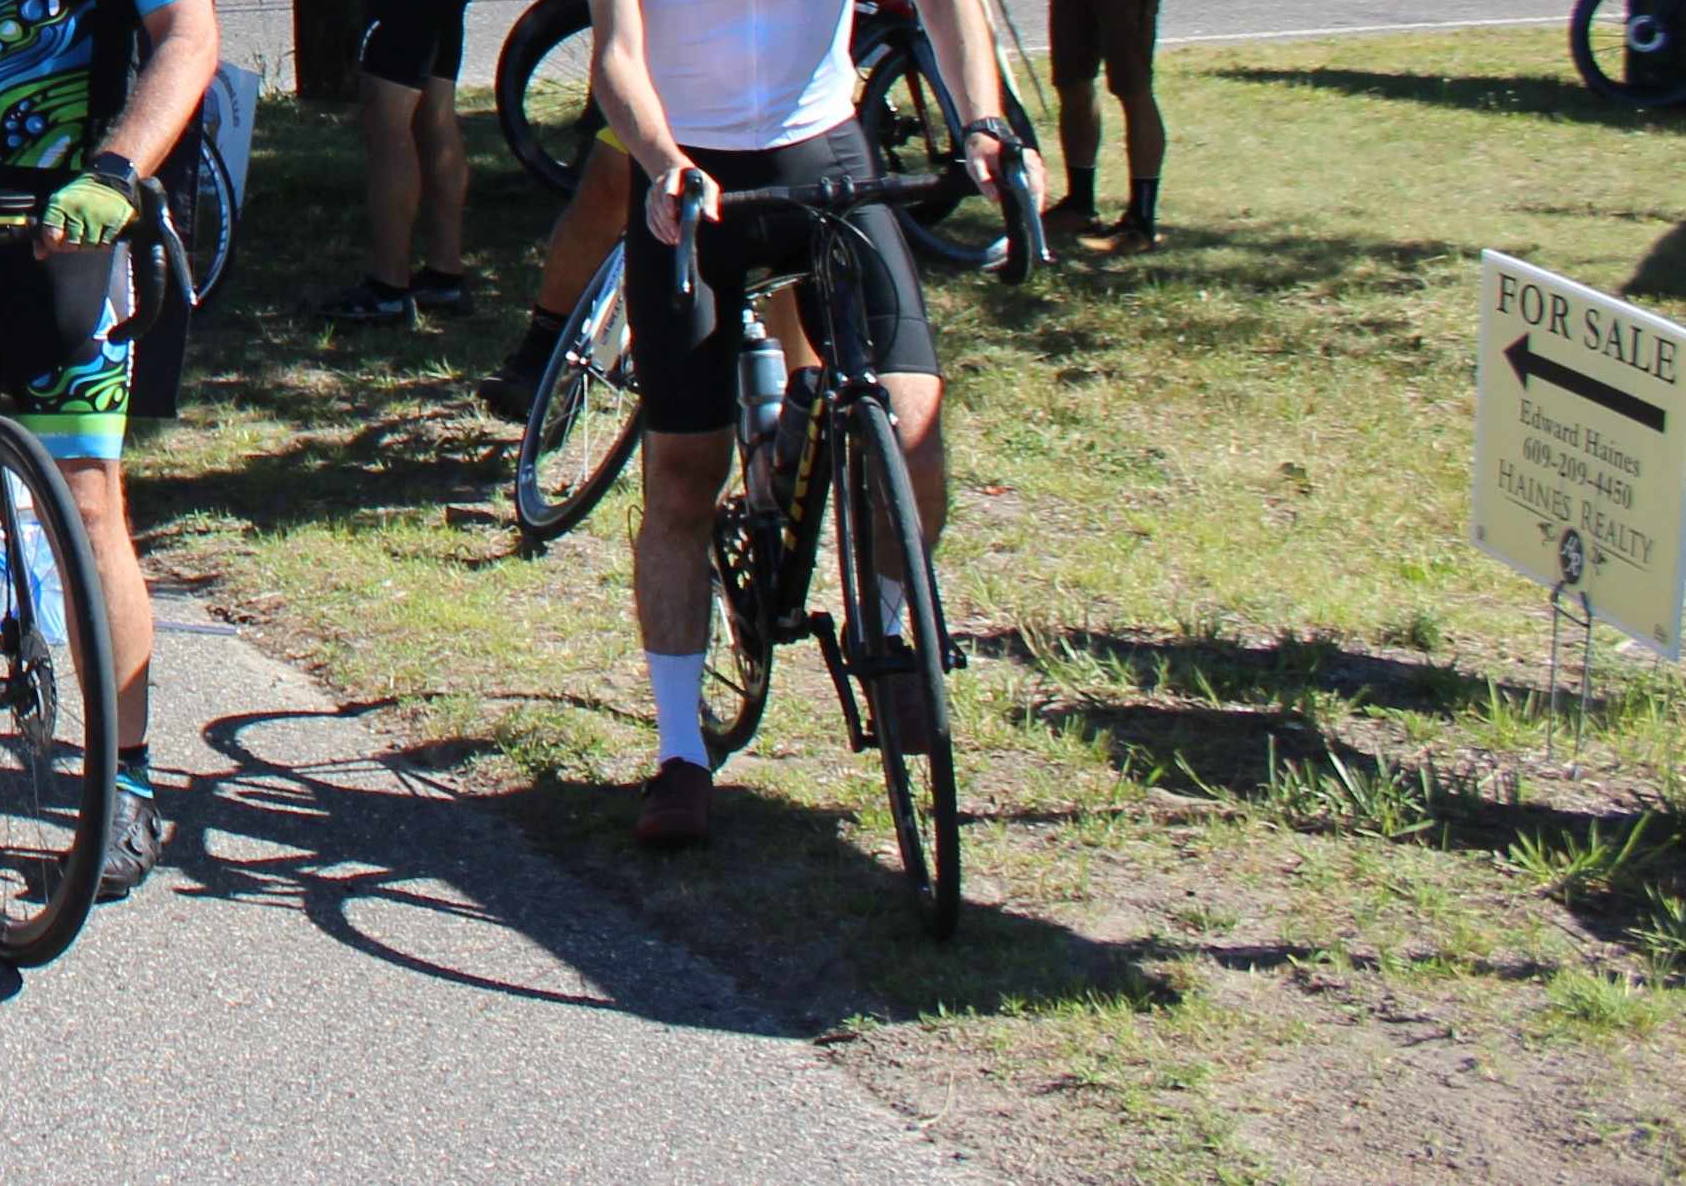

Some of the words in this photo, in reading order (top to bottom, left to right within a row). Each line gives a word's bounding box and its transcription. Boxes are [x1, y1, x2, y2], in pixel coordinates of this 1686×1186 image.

[1496, 272, 1572, 340] FOR
[1584, 308, 1676, 384] SALE
[1520, 399, 1580, 448] Edward
[1585, 428, 1640, 478] Haines
[1523, 437, 1633, 509] 609-209-4450
[1498, 459, 1572, 522] HAINES
[1581, 500, 1654, 564] REALTY
